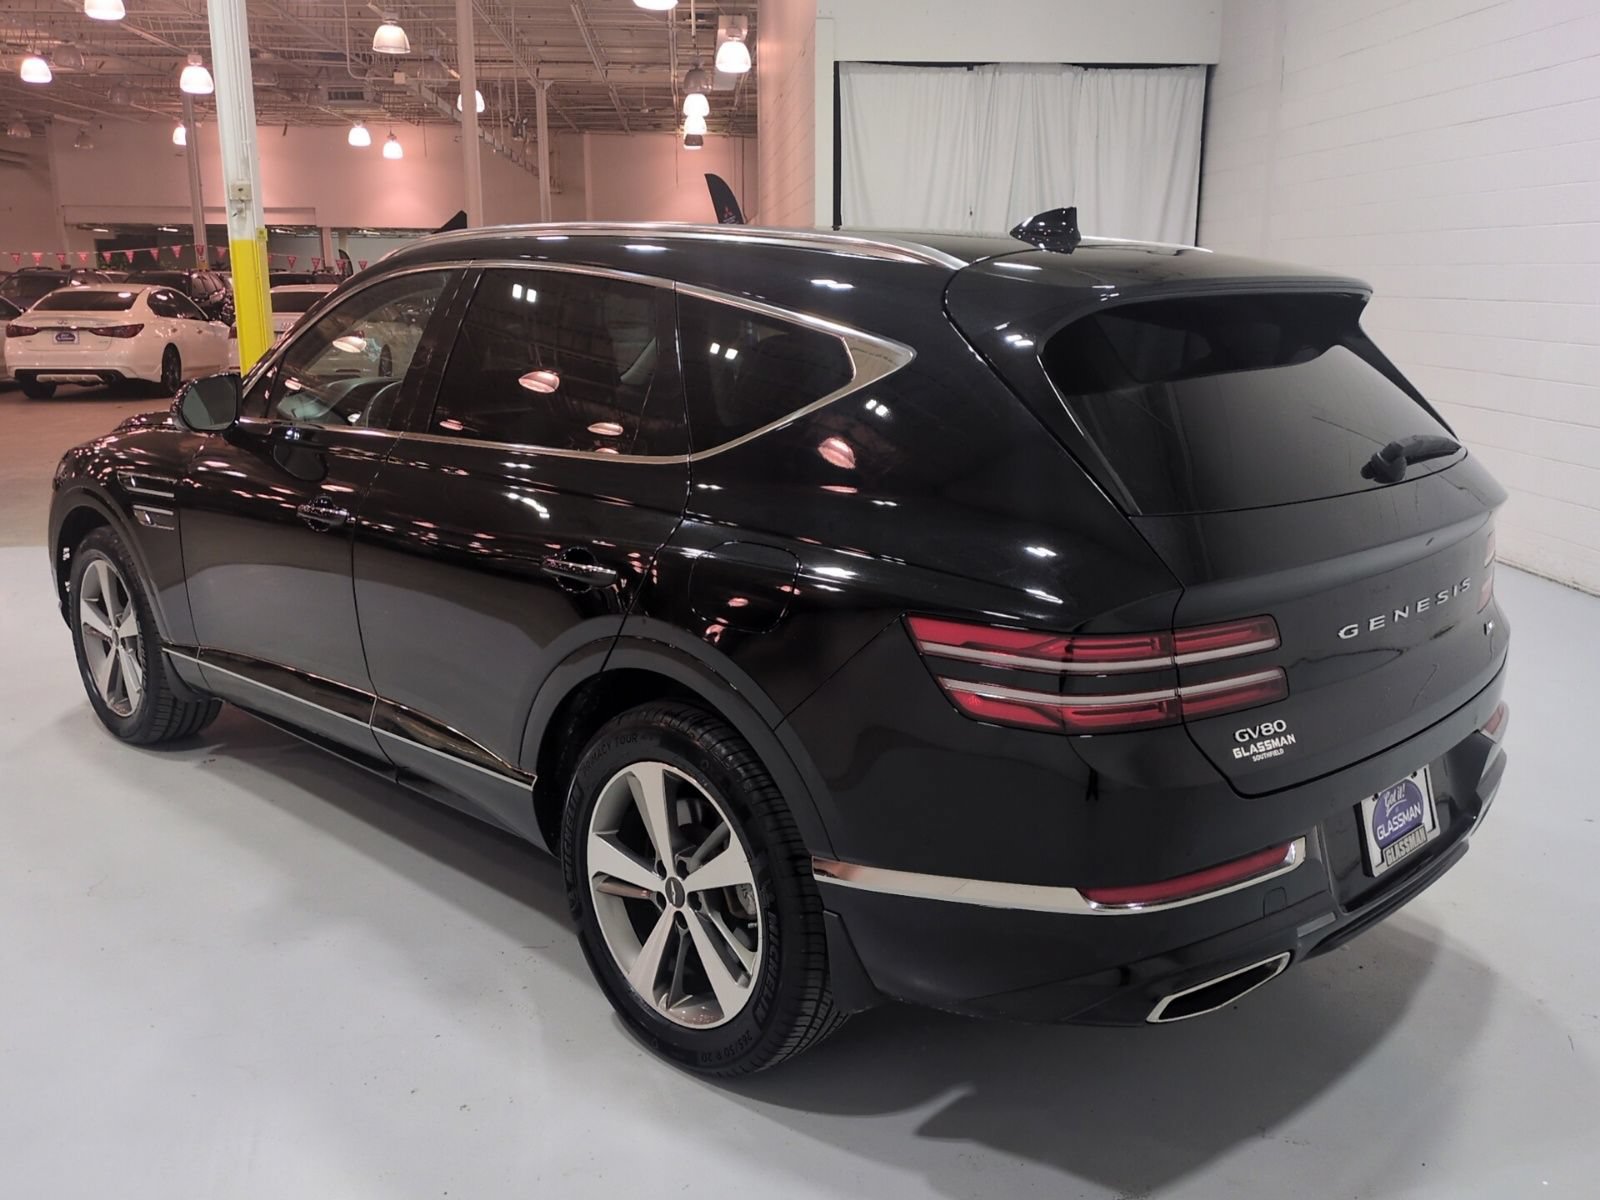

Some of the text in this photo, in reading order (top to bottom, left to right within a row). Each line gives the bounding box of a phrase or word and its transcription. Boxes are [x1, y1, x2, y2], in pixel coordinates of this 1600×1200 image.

[1337, 577, 1473, 640] GENESIS
[614, 733, 639, 746] TOUR
[1234, 719, 1287, 743] GV80
[1232, 733, 1296, 759] GLASSMAN
[1251, 747, 1284, 762] SOUTHFIELD
[1376, 802, 1422, 840] GLASSMAN
[1385, 828, 1427, 863] GLASSMAN
